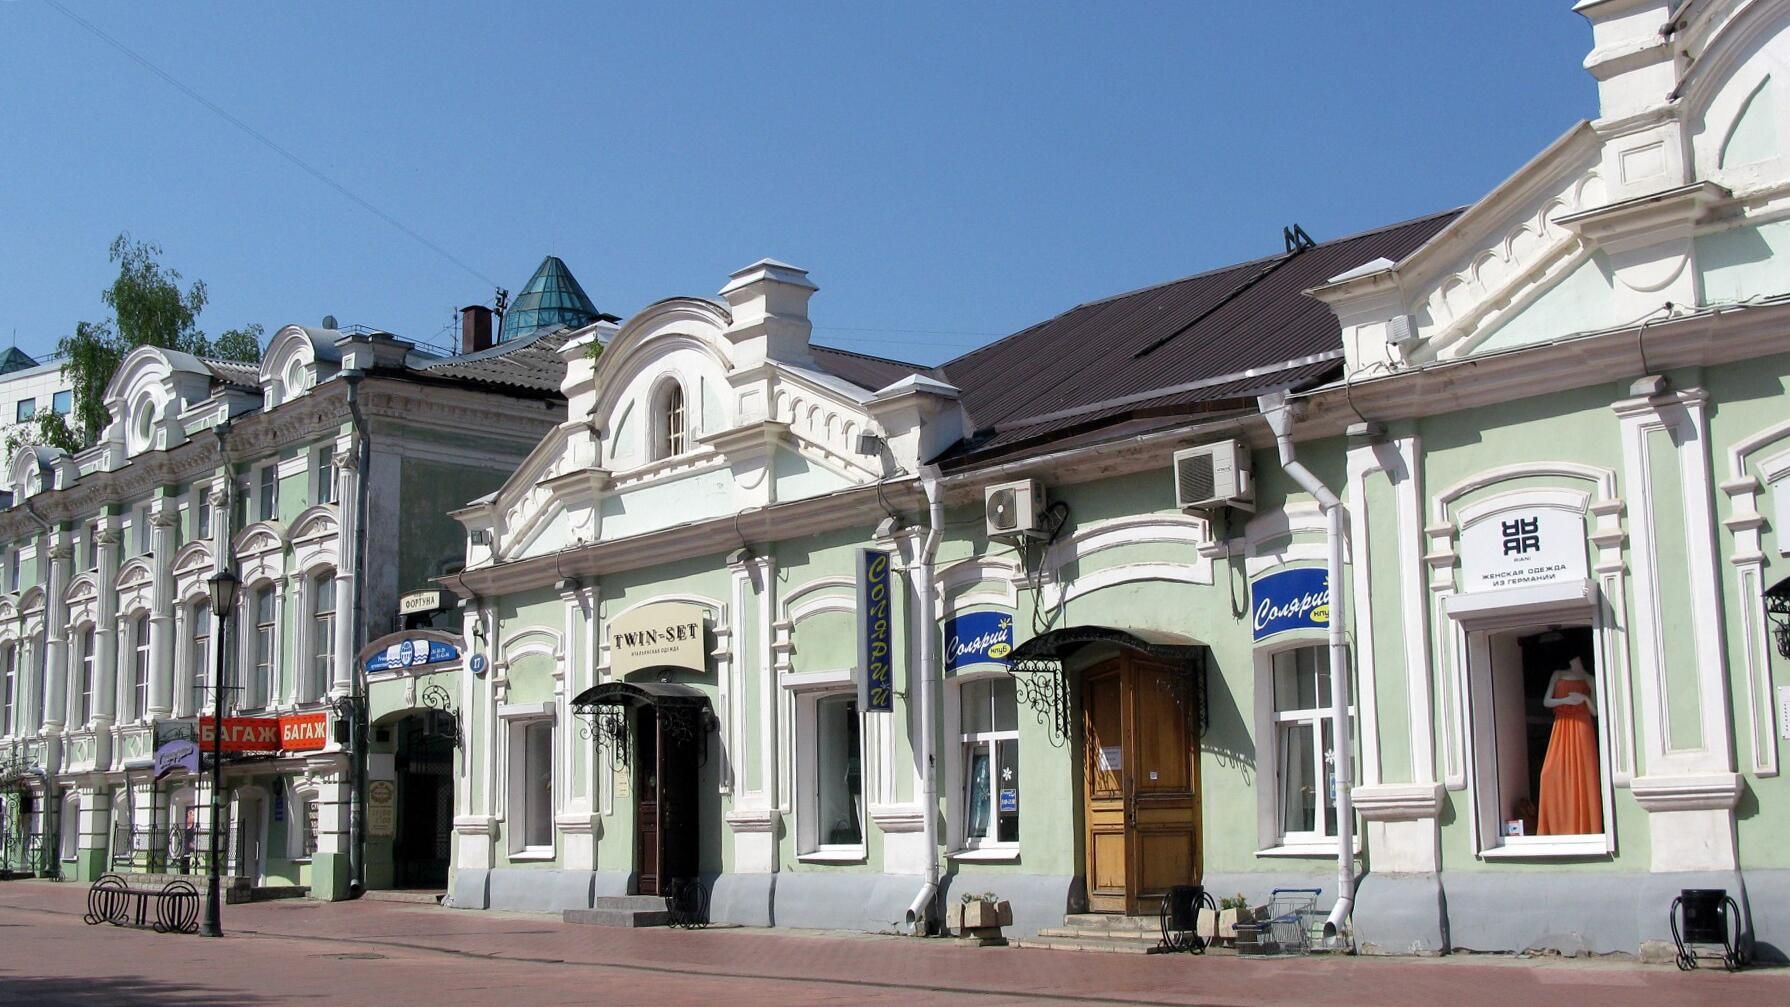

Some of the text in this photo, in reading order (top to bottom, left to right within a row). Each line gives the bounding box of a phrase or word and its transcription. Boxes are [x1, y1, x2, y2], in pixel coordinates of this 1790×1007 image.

[1482, 564, 1567, 580] ЖЕНСКАЯ ОДЕЖДА
[1507, 573, 1556, 585] ГЕРМАНИИ
[405, 596, 435, 609] ФОРТУНА
[1313, 610, 1329, 619] клу
[613, 623, 698, 650] TWIN-SET
[473, 657, 481, 669] 17
[283, 722, 326, 741] БАГАЖ
